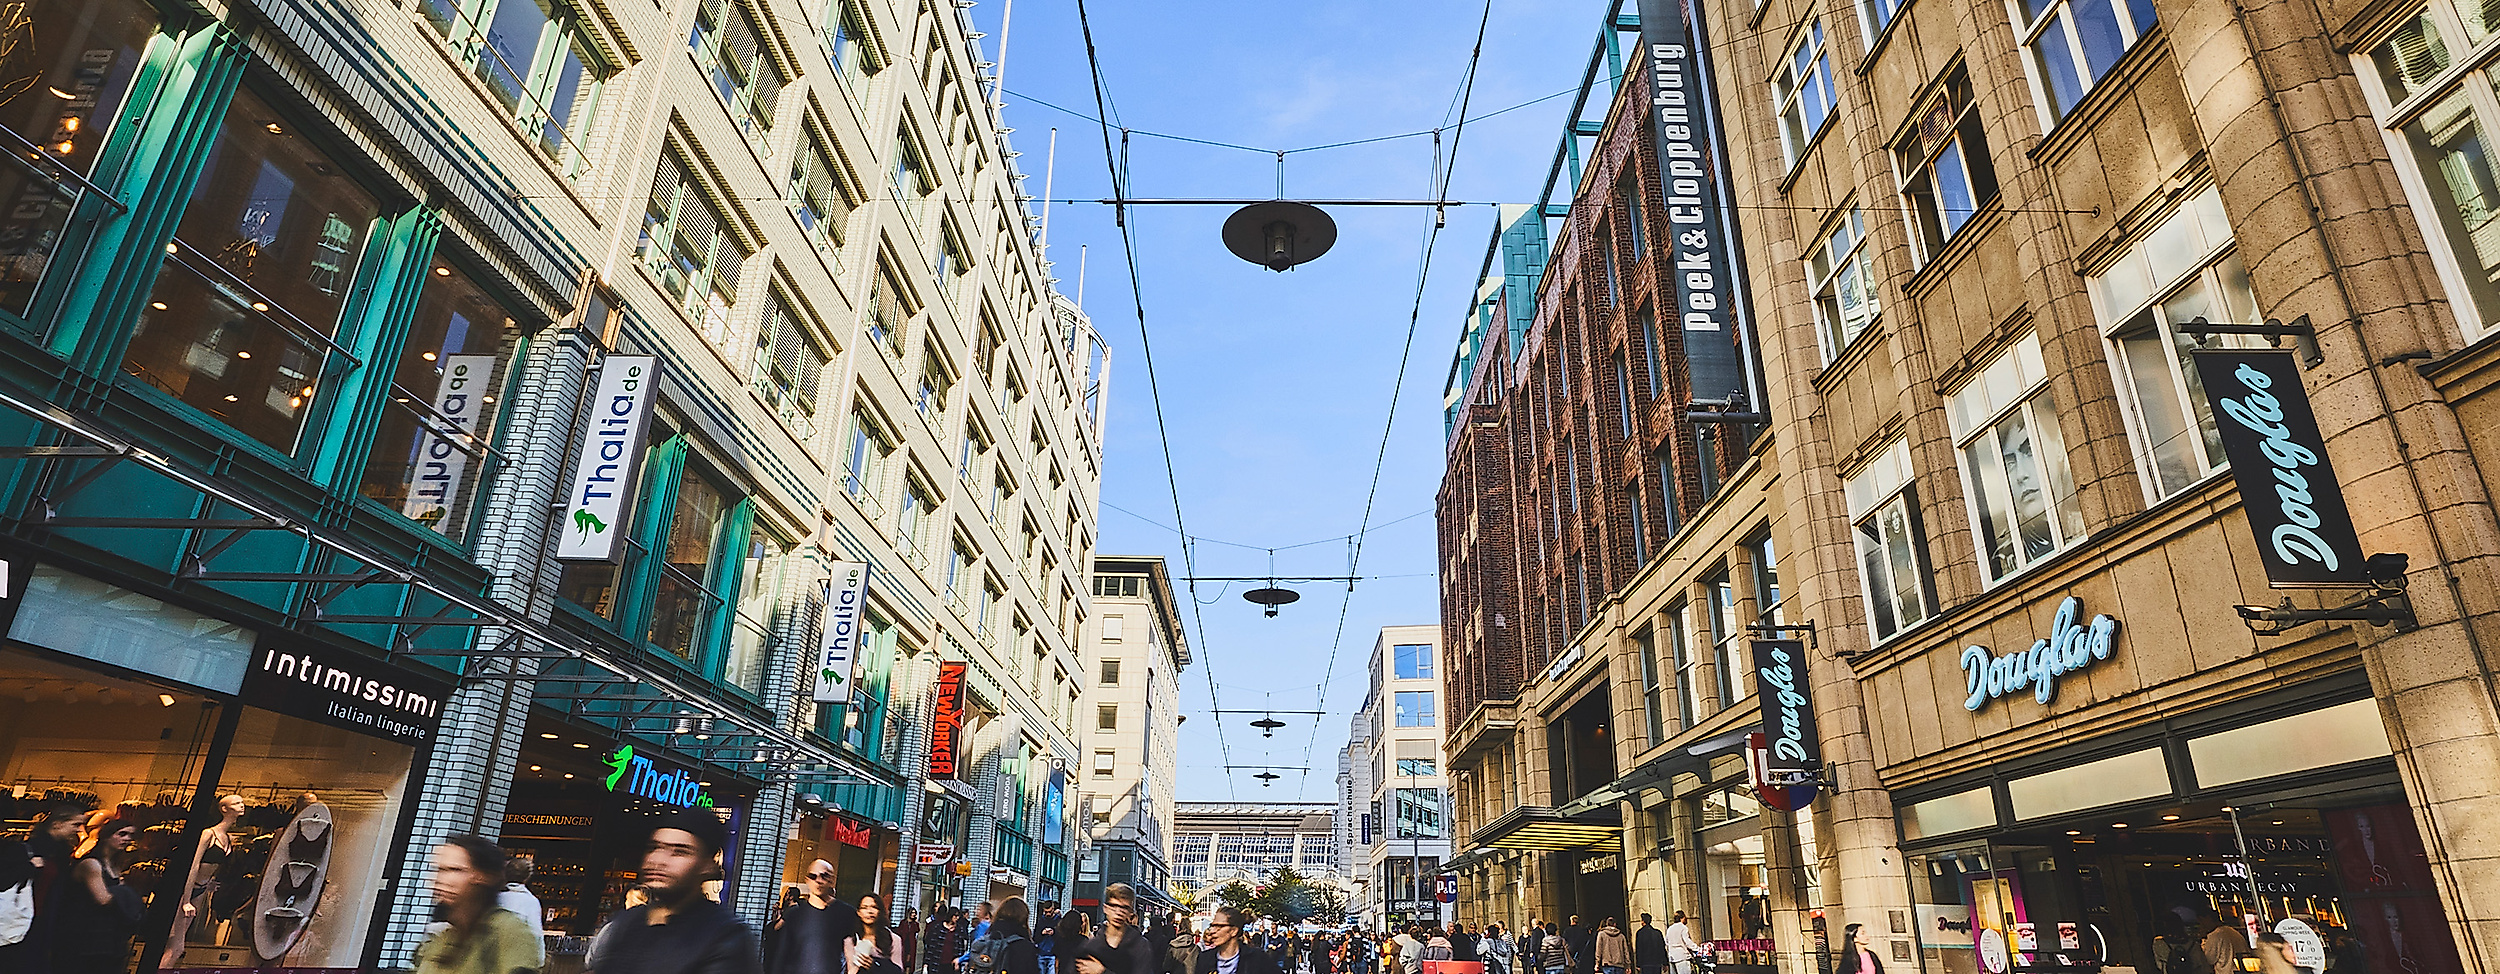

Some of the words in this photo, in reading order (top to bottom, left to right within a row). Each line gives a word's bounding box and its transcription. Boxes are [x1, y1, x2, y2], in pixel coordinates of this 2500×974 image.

[2219, 362, 2339, 572] Douglas
[1961, 596, 2115, 711] Douglas
[327, 700, 373, 726] Italian
[377, 713, 426, 740] lingerie
[1760, 646, 1808, 763] Douglas
[1003, 776, 1011, 798] MODA
[1436, 880, 1457, 894] P&C
[2185, 881, 2241, 894] URBAN
